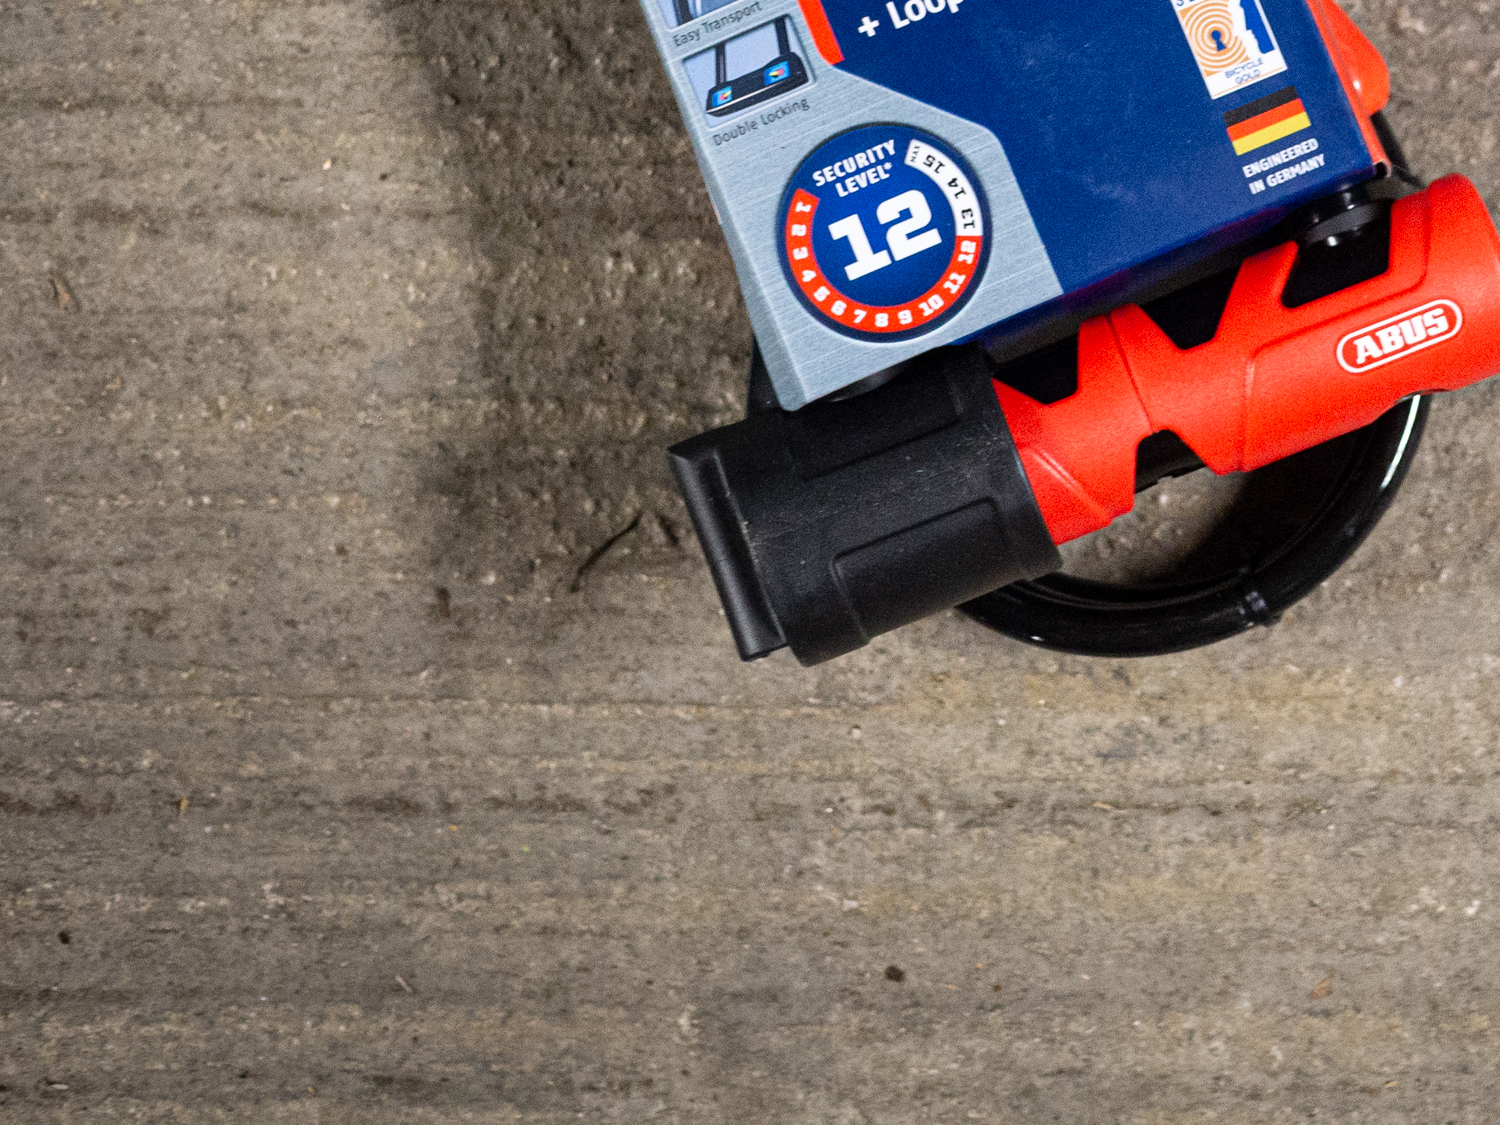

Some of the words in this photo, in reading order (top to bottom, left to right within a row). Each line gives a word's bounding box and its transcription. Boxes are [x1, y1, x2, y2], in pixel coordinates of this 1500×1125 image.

[673, 28, 701, 46] Easy
[702, 1, 763, 34] Transport
[858, 16, 880, 37] +
[713, 120, 758, 146] Double
[760, 99, 810, 125] Locking
[812, 139, 896, 187] SECURITY
[923, 154, 945, 174] 15
[1242, 138, 1319, 178] ENGINEERED
[1249, 179, 1266, 195] IN
[1266, 153, 1325, 187] GERMANY
[947, 178, 966, 199] 14
[795, 201, 811, 212] 1
[961, 208, 975, 229] 13
[791, 224, 806, 236] 2
[828, 189, 942, 281] 12
[793, 246, 808, 260] 3
[957, 241, 976, 264] 12
[802, 269, 816, 282] 4
[943, 272, 966, 294] 11
[813, 286, 830, 301] 5
[831, 300, 847, 315] 6
[918, 294, 944, 316] 10
[853, 309, 867, 323] 7
[875, 313, 888, 327] 8
[898, 309, 913, 324] 9
[1353, 308, 1449, 364] ABUS
